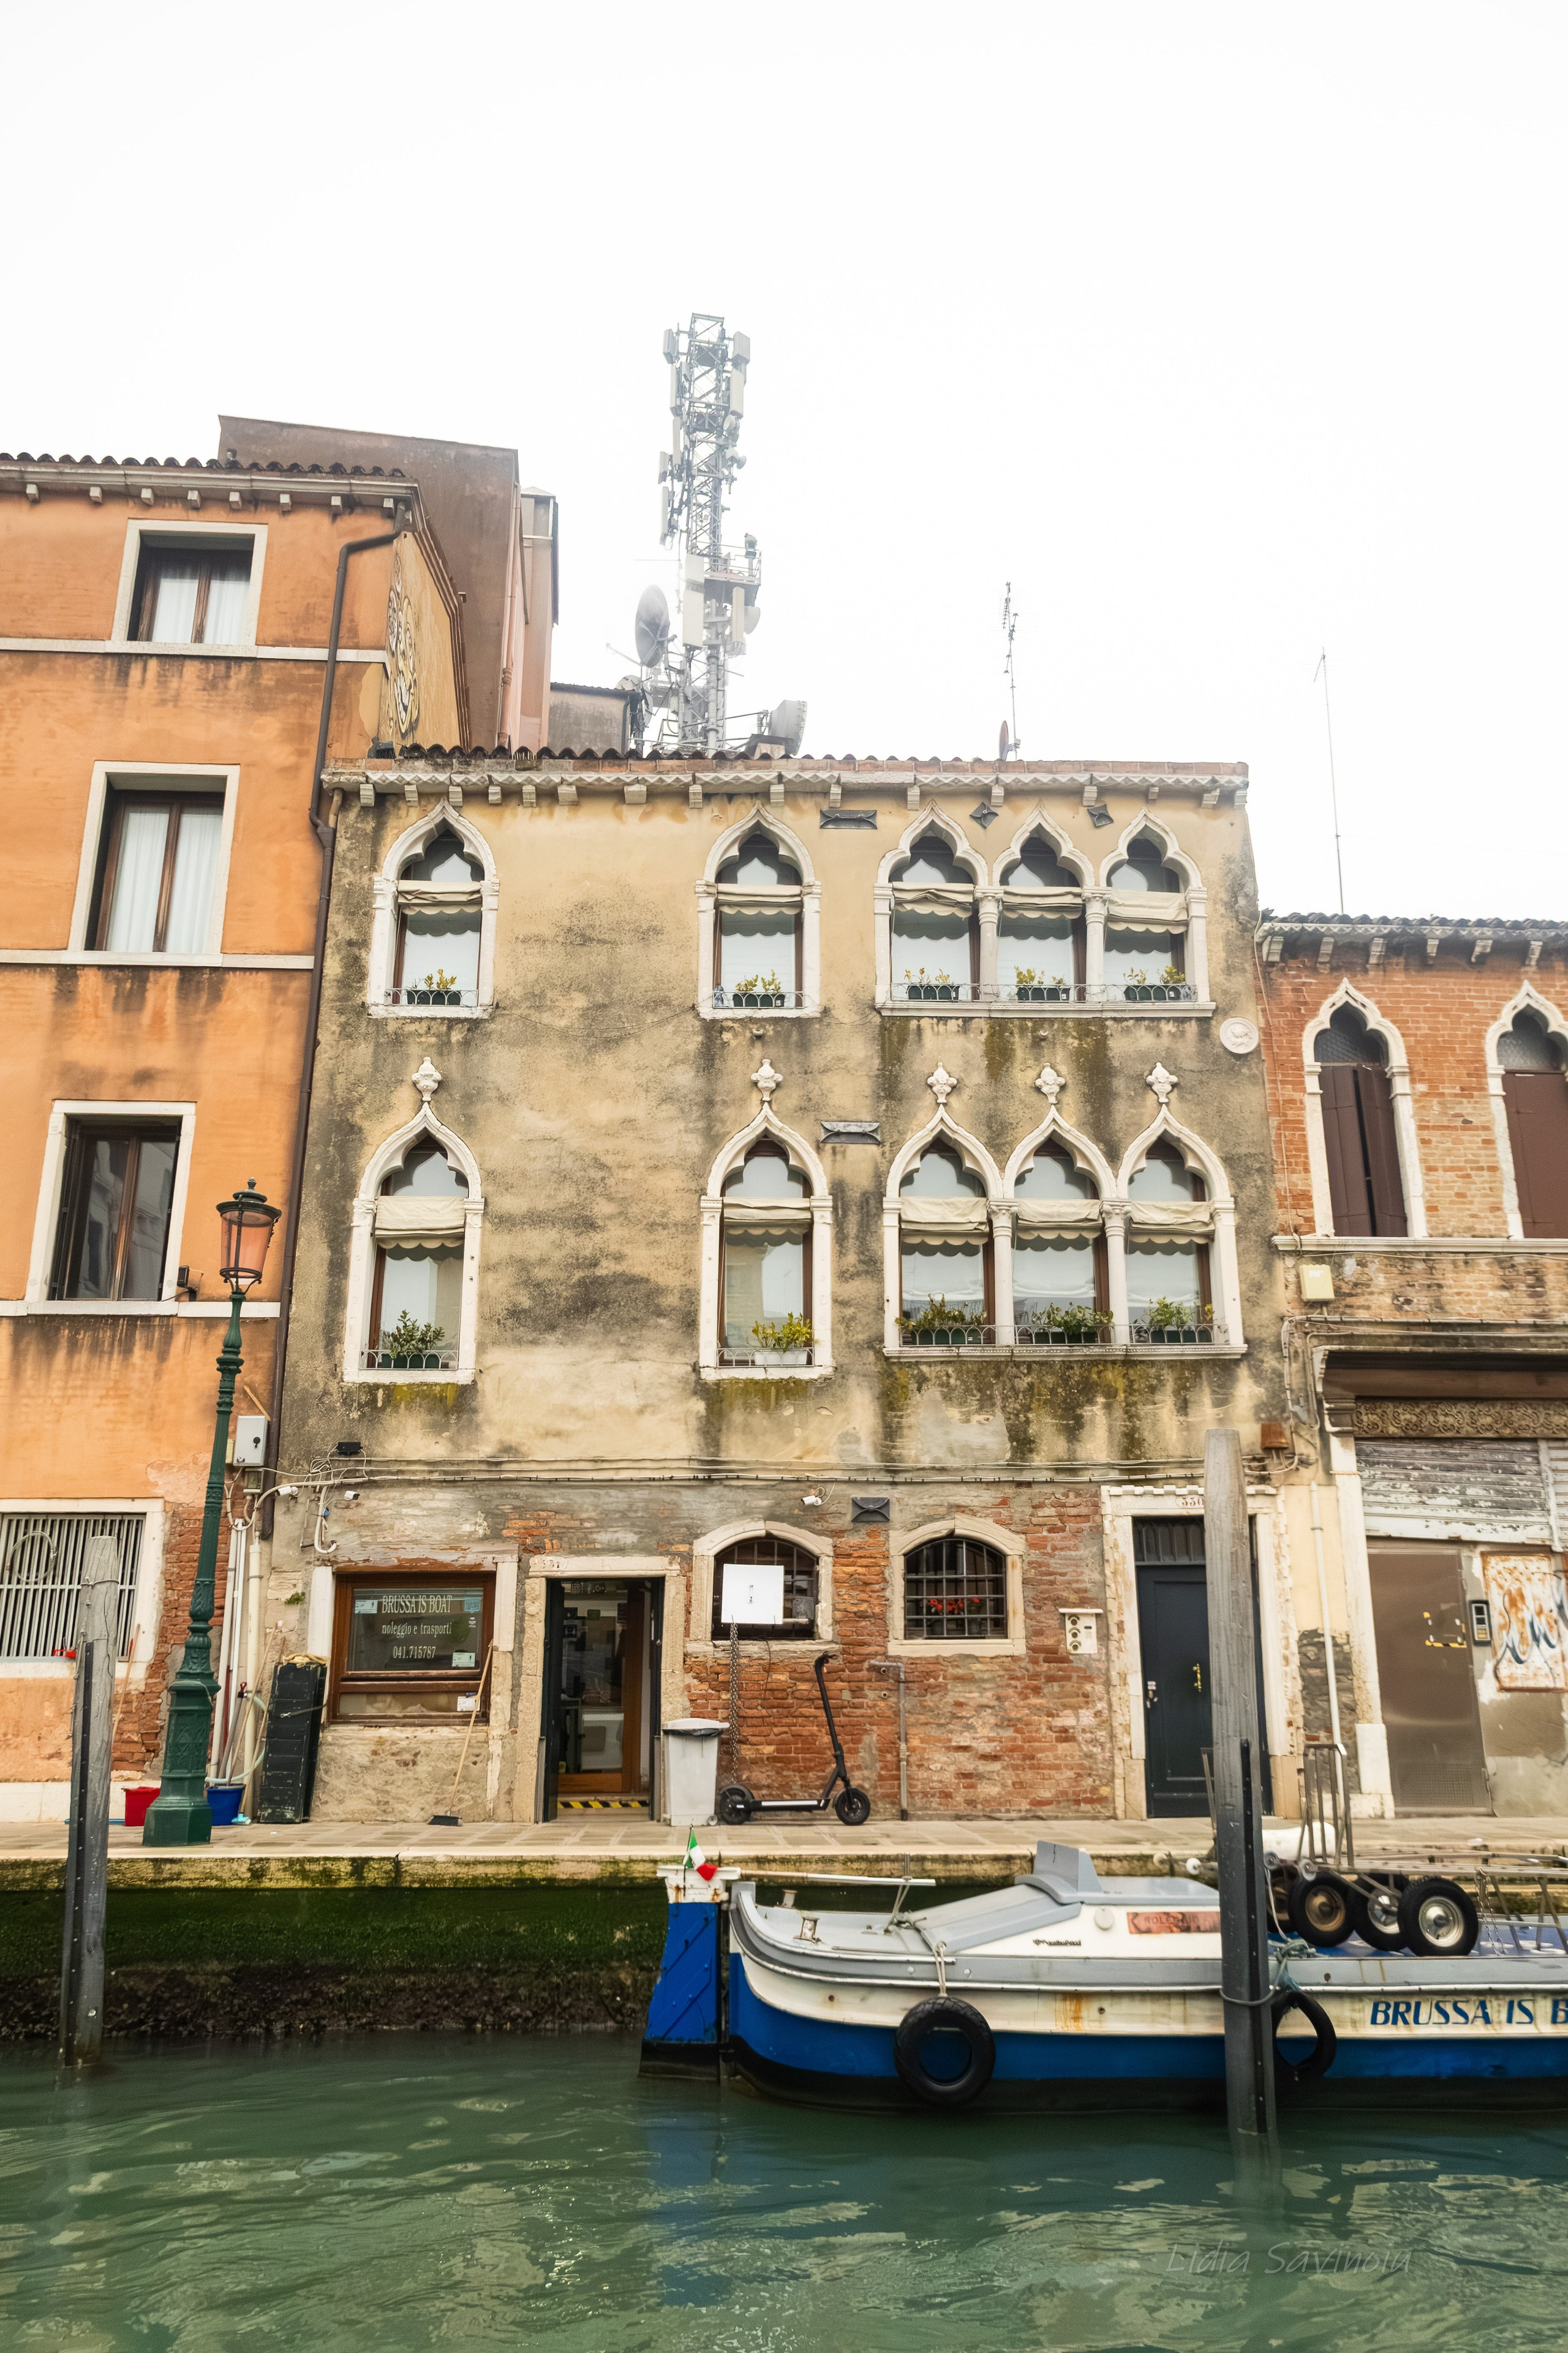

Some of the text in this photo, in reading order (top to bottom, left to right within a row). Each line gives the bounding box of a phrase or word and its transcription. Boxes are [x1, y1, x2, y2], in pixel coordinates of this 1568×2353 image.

[382, 1595, 417, 1613] BRUSSA
[418, 1595, 427, 1613] IS
[429, 1595, 453, 1613] BOAT
[382, 1621, 412, 1638] noleggio
[413, 1625, 418, 1634] e
[420, 1622, 452, 1637] trasporti
[393, 1645, 436, 1658] 041.715787
[1370, 1999, 1491, 2025] BRUSSA
[1507, 1999, 1534, 2025] IS
